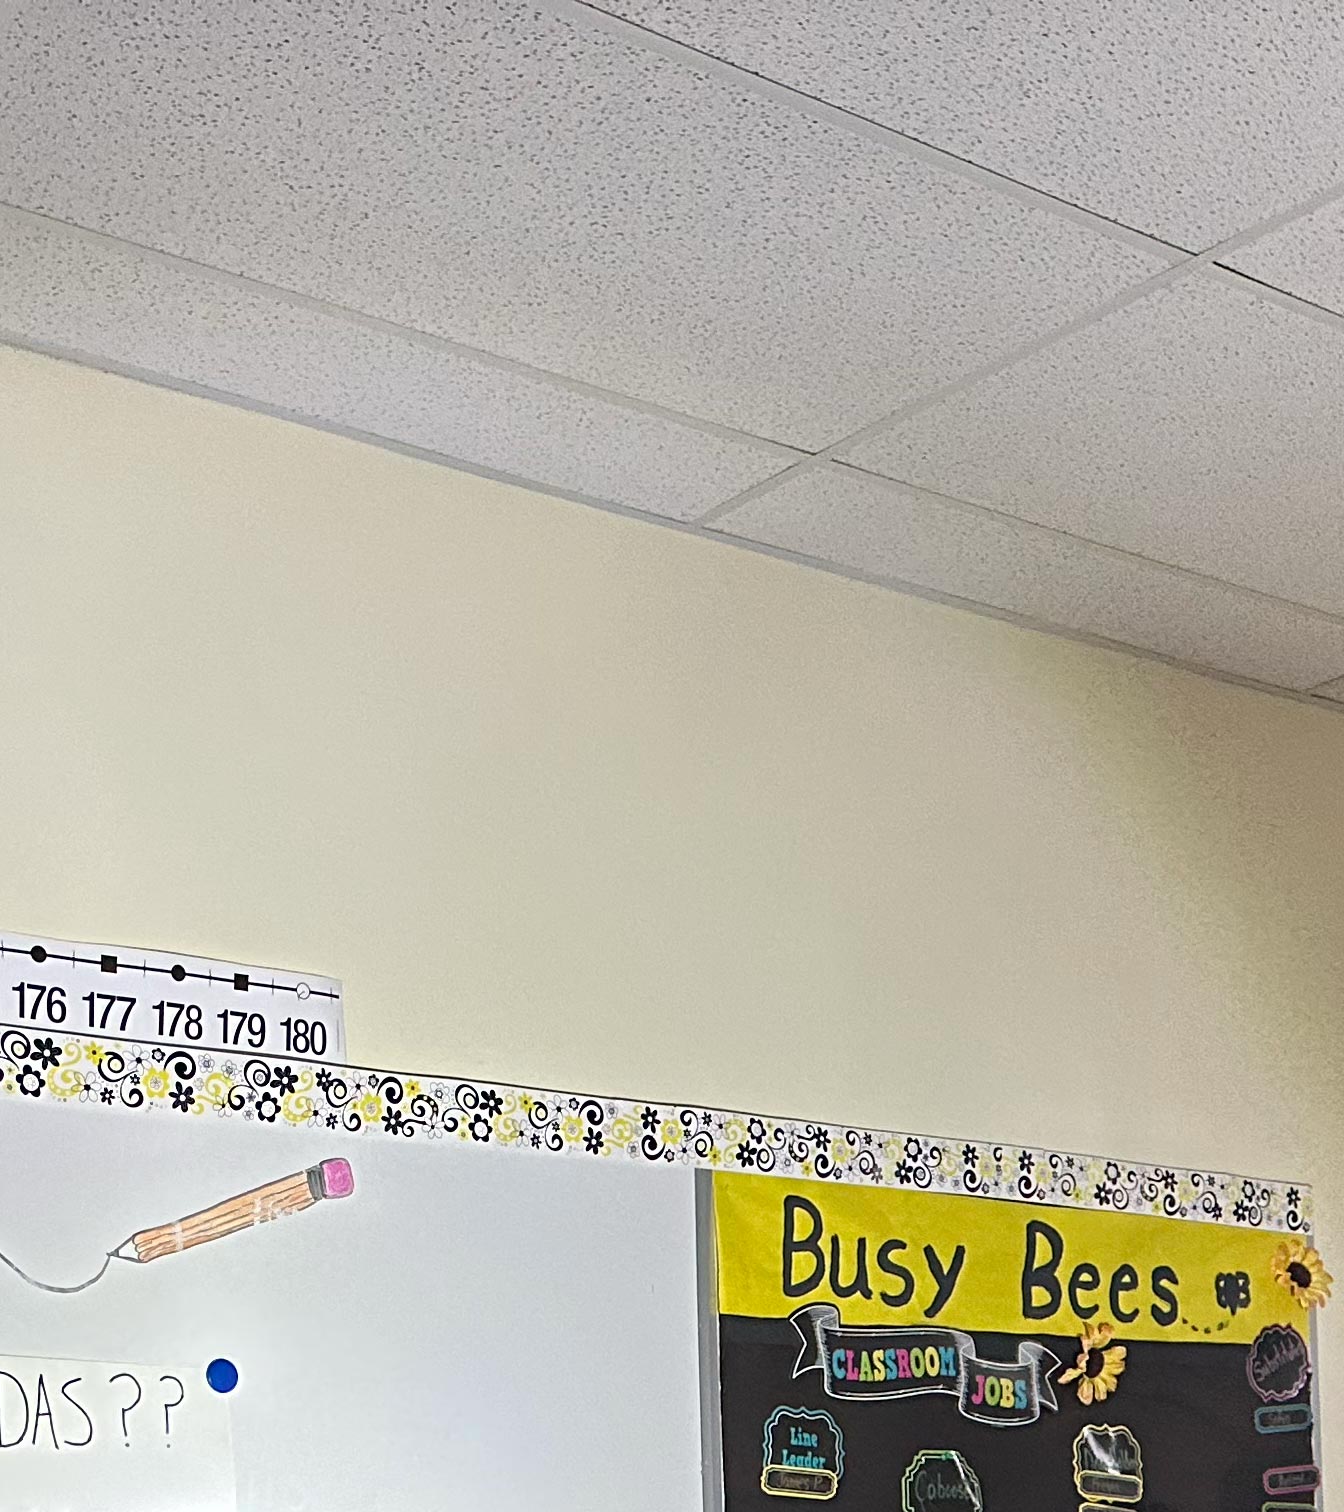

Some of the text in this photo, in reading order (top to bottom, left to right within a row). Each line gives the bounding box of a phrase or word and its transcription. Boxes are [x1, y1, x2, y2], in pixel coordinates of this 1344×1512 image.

[11, 981, 67, 1024] 176
[82, 991, 137, 1032] 177
[153, 1000, 204, 1039] 178
[217, 1009, 267, 1047] 179
[279, 1016, 328, 1055] 180
[781, 1194, 1181, 1328] Busy Bees
[832, 1344, 1027, 1410] CLASSROOM JOBS
[781, 1449, 826, 1470] Leader
[789, 1426, 819, 1448] Line
